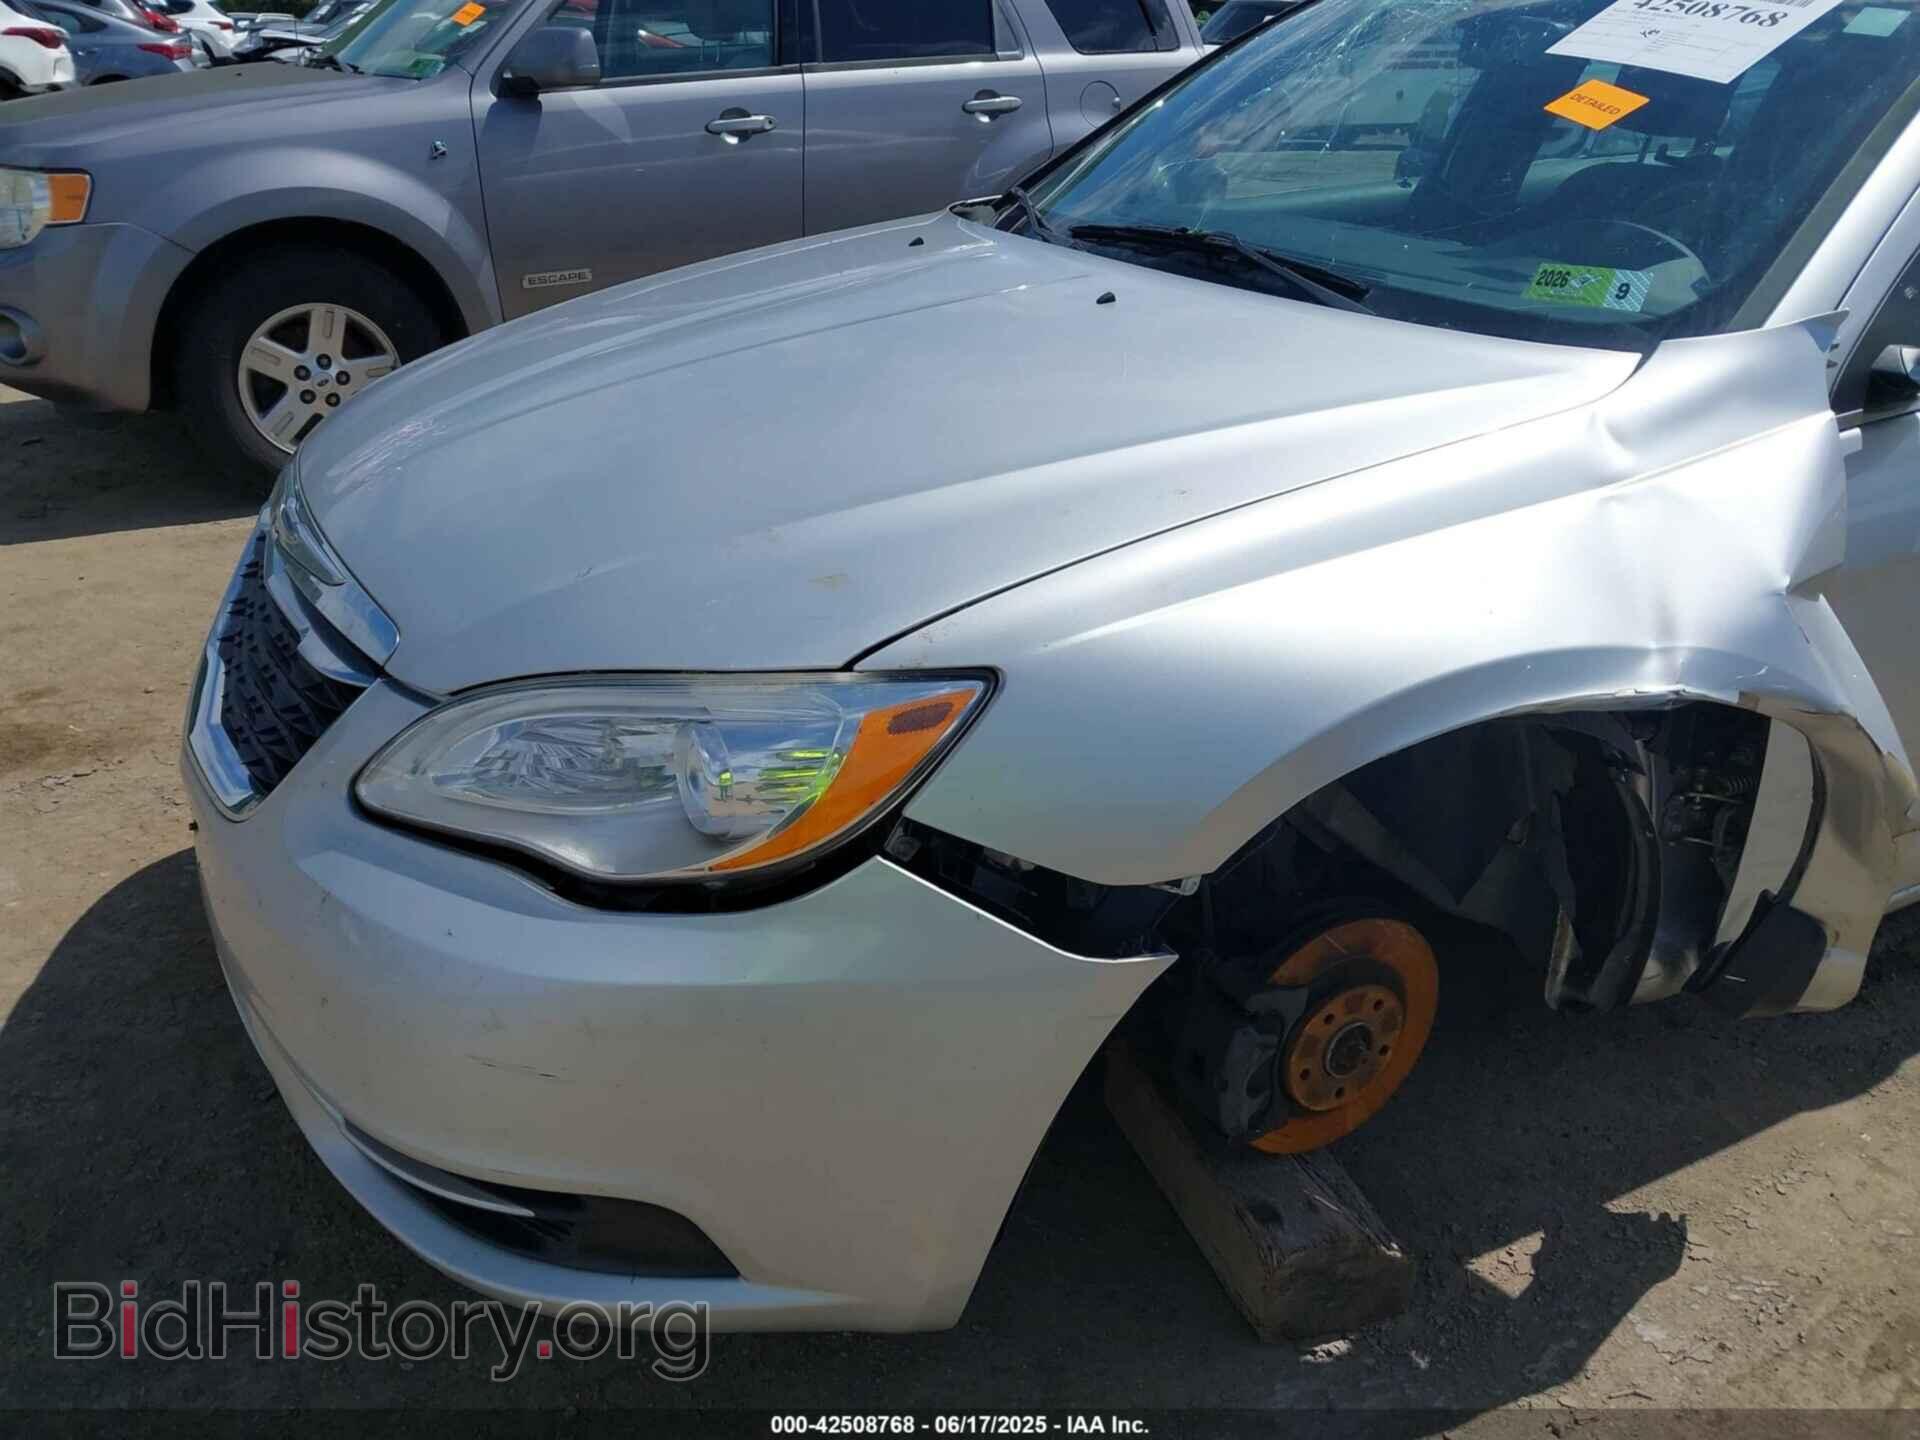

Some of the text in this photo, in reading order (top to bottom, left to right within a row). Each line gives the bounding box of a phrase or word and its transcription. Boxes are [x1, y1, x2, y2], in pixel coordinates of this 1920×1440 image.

[1634, 0, 1788, 27] 42508768
[1569, 93, 1621, 115] DETAILED
[527, 271, 588, 285] ESCAPE
[1535, 269, 1571, 288] 2026
[1615, 282, 1631, 300] 9
